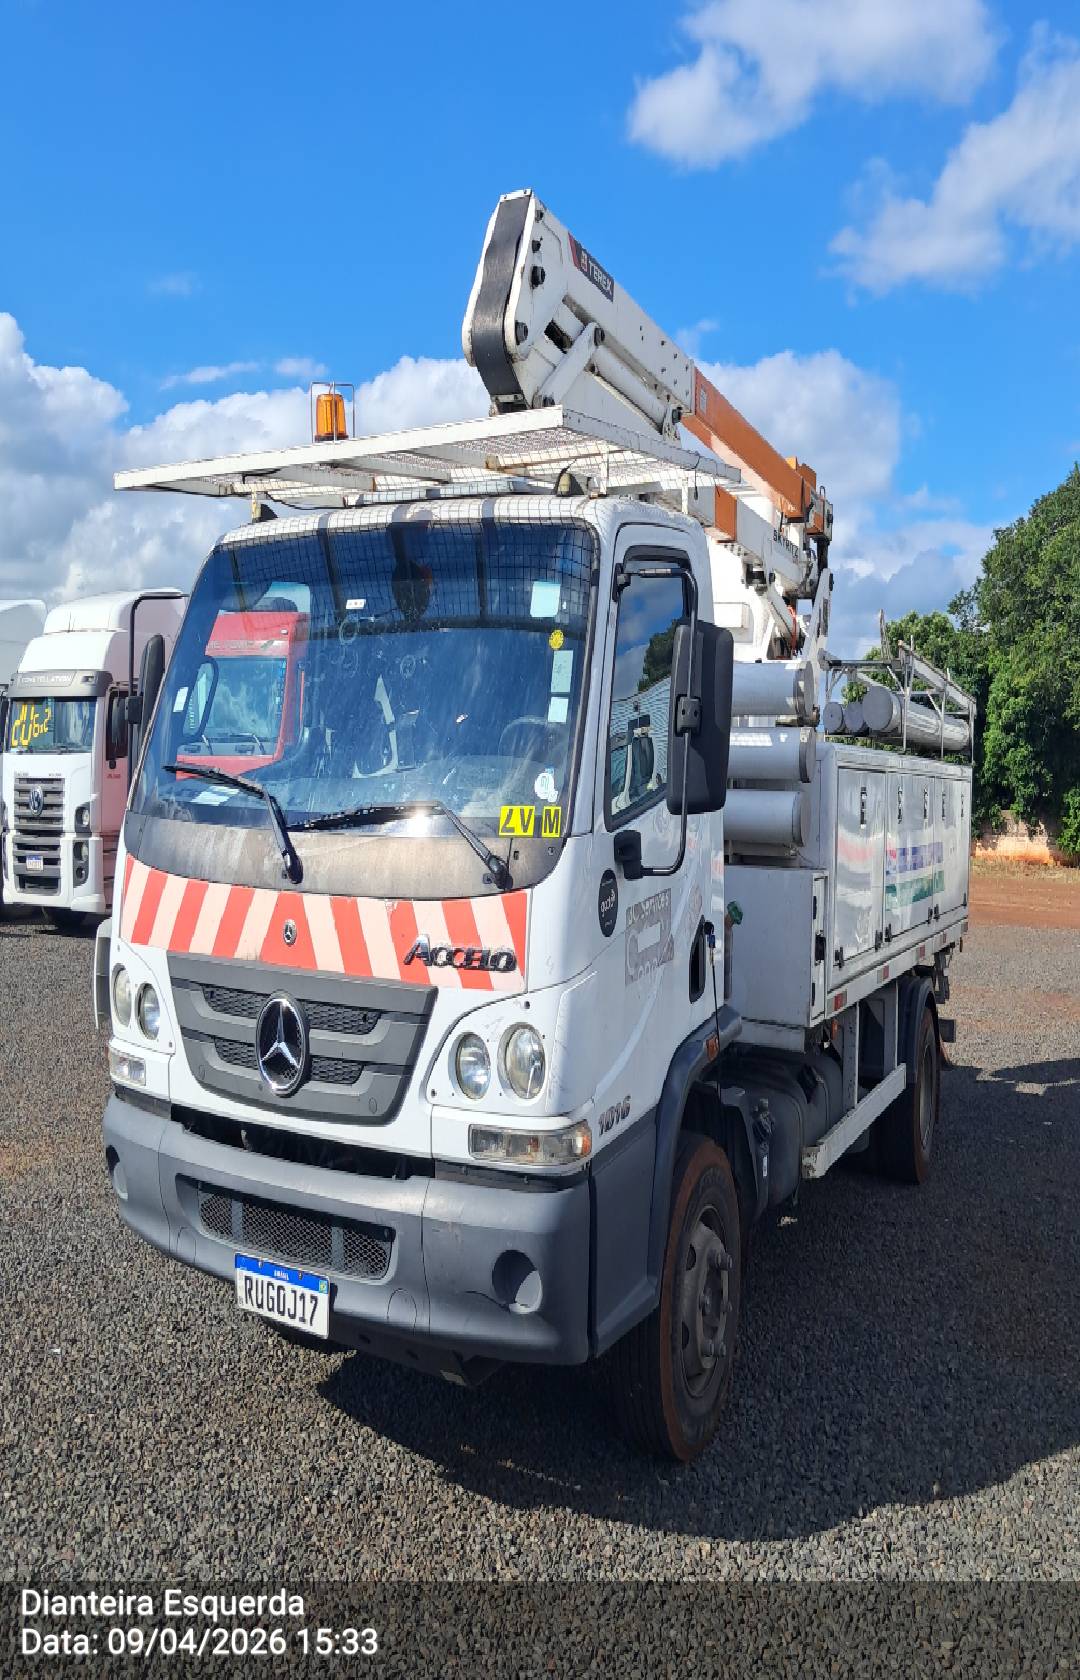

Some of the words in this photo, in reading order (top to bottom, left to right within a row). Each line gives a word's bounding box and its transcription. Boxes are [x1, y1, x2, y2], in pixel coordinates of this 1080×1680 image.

[588, 260, 612, 297] TEREX
[402, 933, 517, 973] ACCELO
[598, 1095, 631, 1136] 1016
